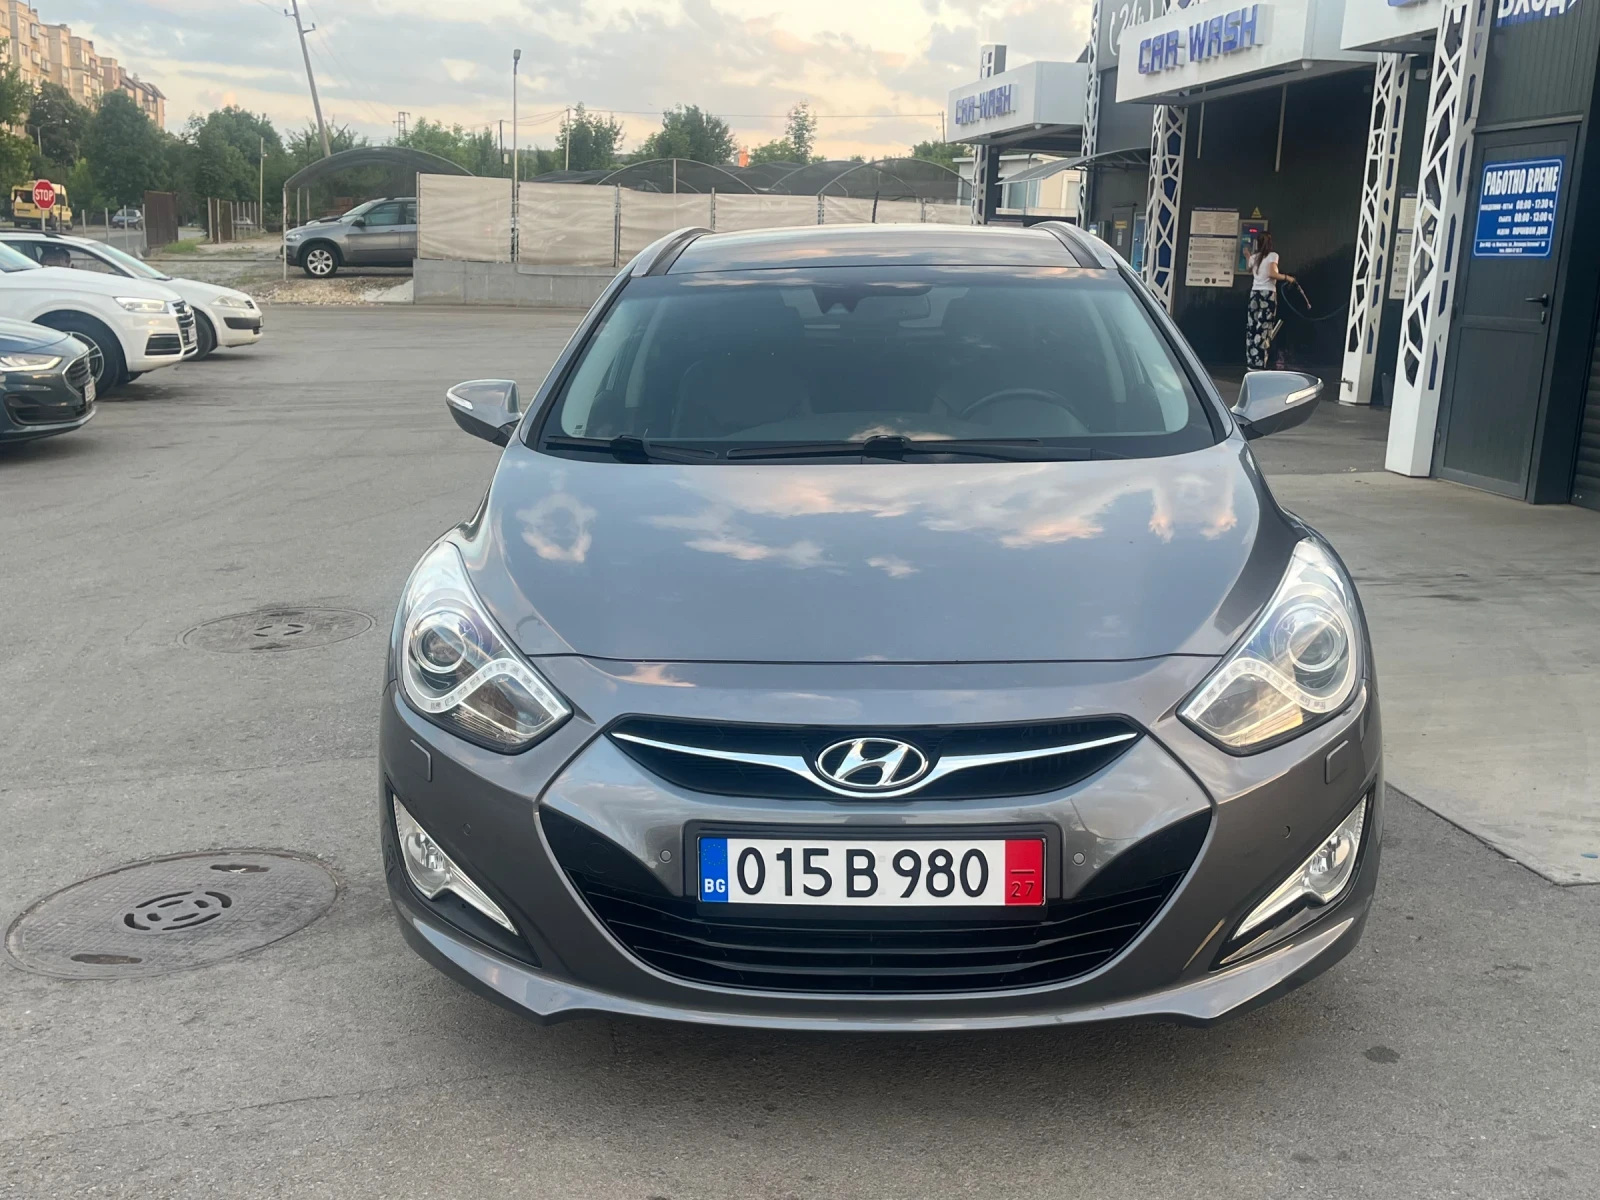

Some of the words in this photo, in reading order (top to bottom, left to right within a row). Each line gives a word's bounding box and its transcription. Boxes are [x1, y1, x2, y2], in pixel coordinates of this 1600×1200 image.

[1138, 29, 1180, 75] CAR
[1189, 3, 1259, 63] WASH
[955, 95, 975, 125] CAR
[979, 83, 1012, 119] WASH
[35, 189, 54, 200] STOP
[1484, 168, 1526, 196] РАБОТНО
[1526, 166, 1559, 194] ВРЕМЕ
[703, 878, 727, 894] BG
[736, 846, 834, 898] 015
[845, 848, 879, 898] B
[892, 848, 990, 898] 980
[1010, 880, 1035, 898] 27
